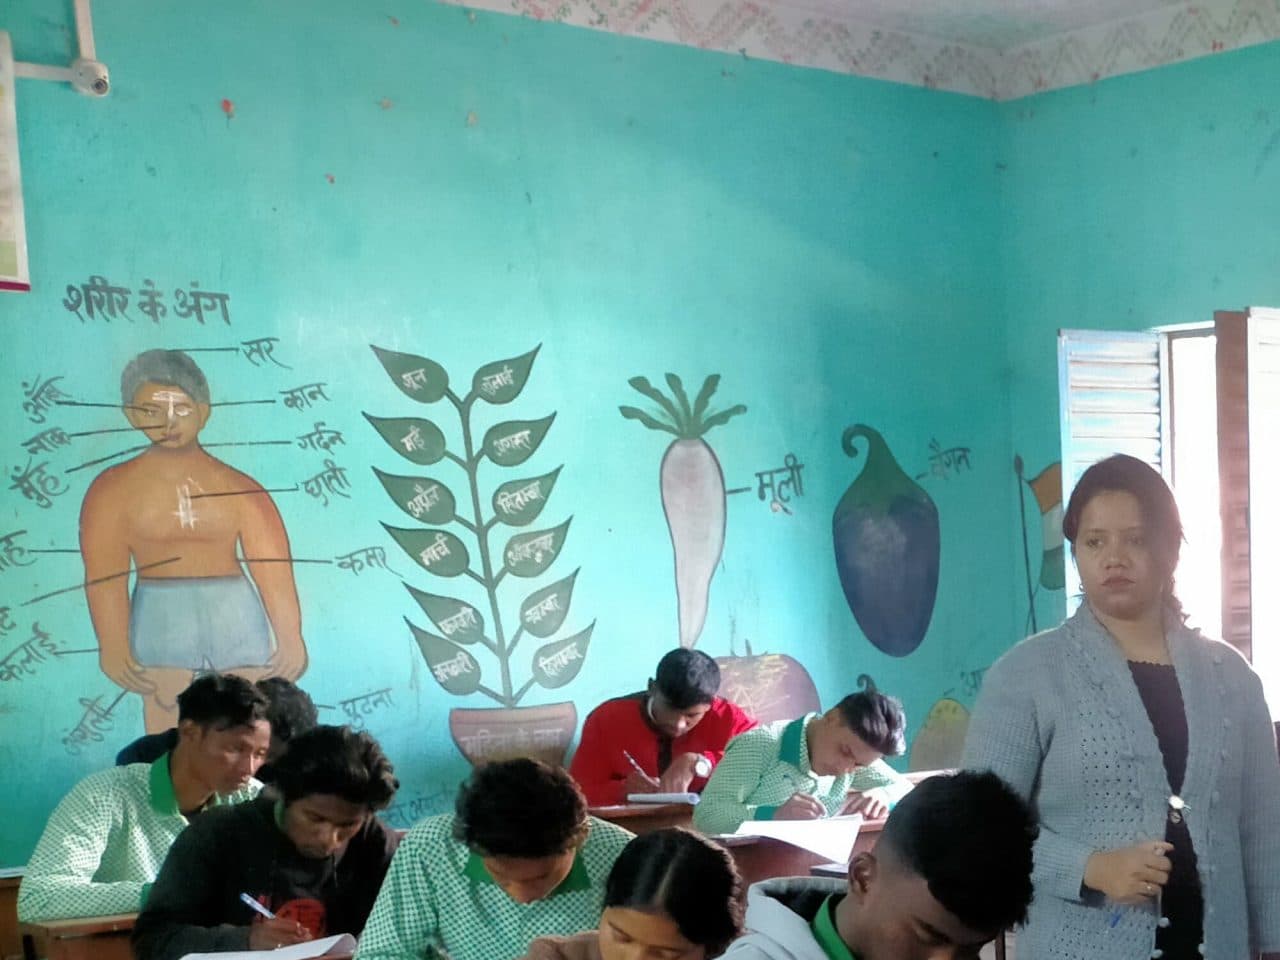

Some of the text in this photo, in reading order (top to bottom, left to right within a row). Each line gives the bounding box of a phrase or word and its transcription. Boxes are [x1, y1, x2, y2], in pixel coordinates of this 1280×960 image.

[63, 274, 232, 326] शरीर के अंग
[402, 367, 428, 392] जून
[279, 381, 330, 411] कान
[21, 426, 72, 455] नाक
[297, 421, 346, 451] गर्दन
[400, 425, 425, 452] मई
[493, 430, 533, 457] अगस्त
[304, 460, 351, 506] छाती
[755, 452, 805, 516] मूली
[336, 546, 404, 577] कमर
[419, 532, 451, 567] मार्च
